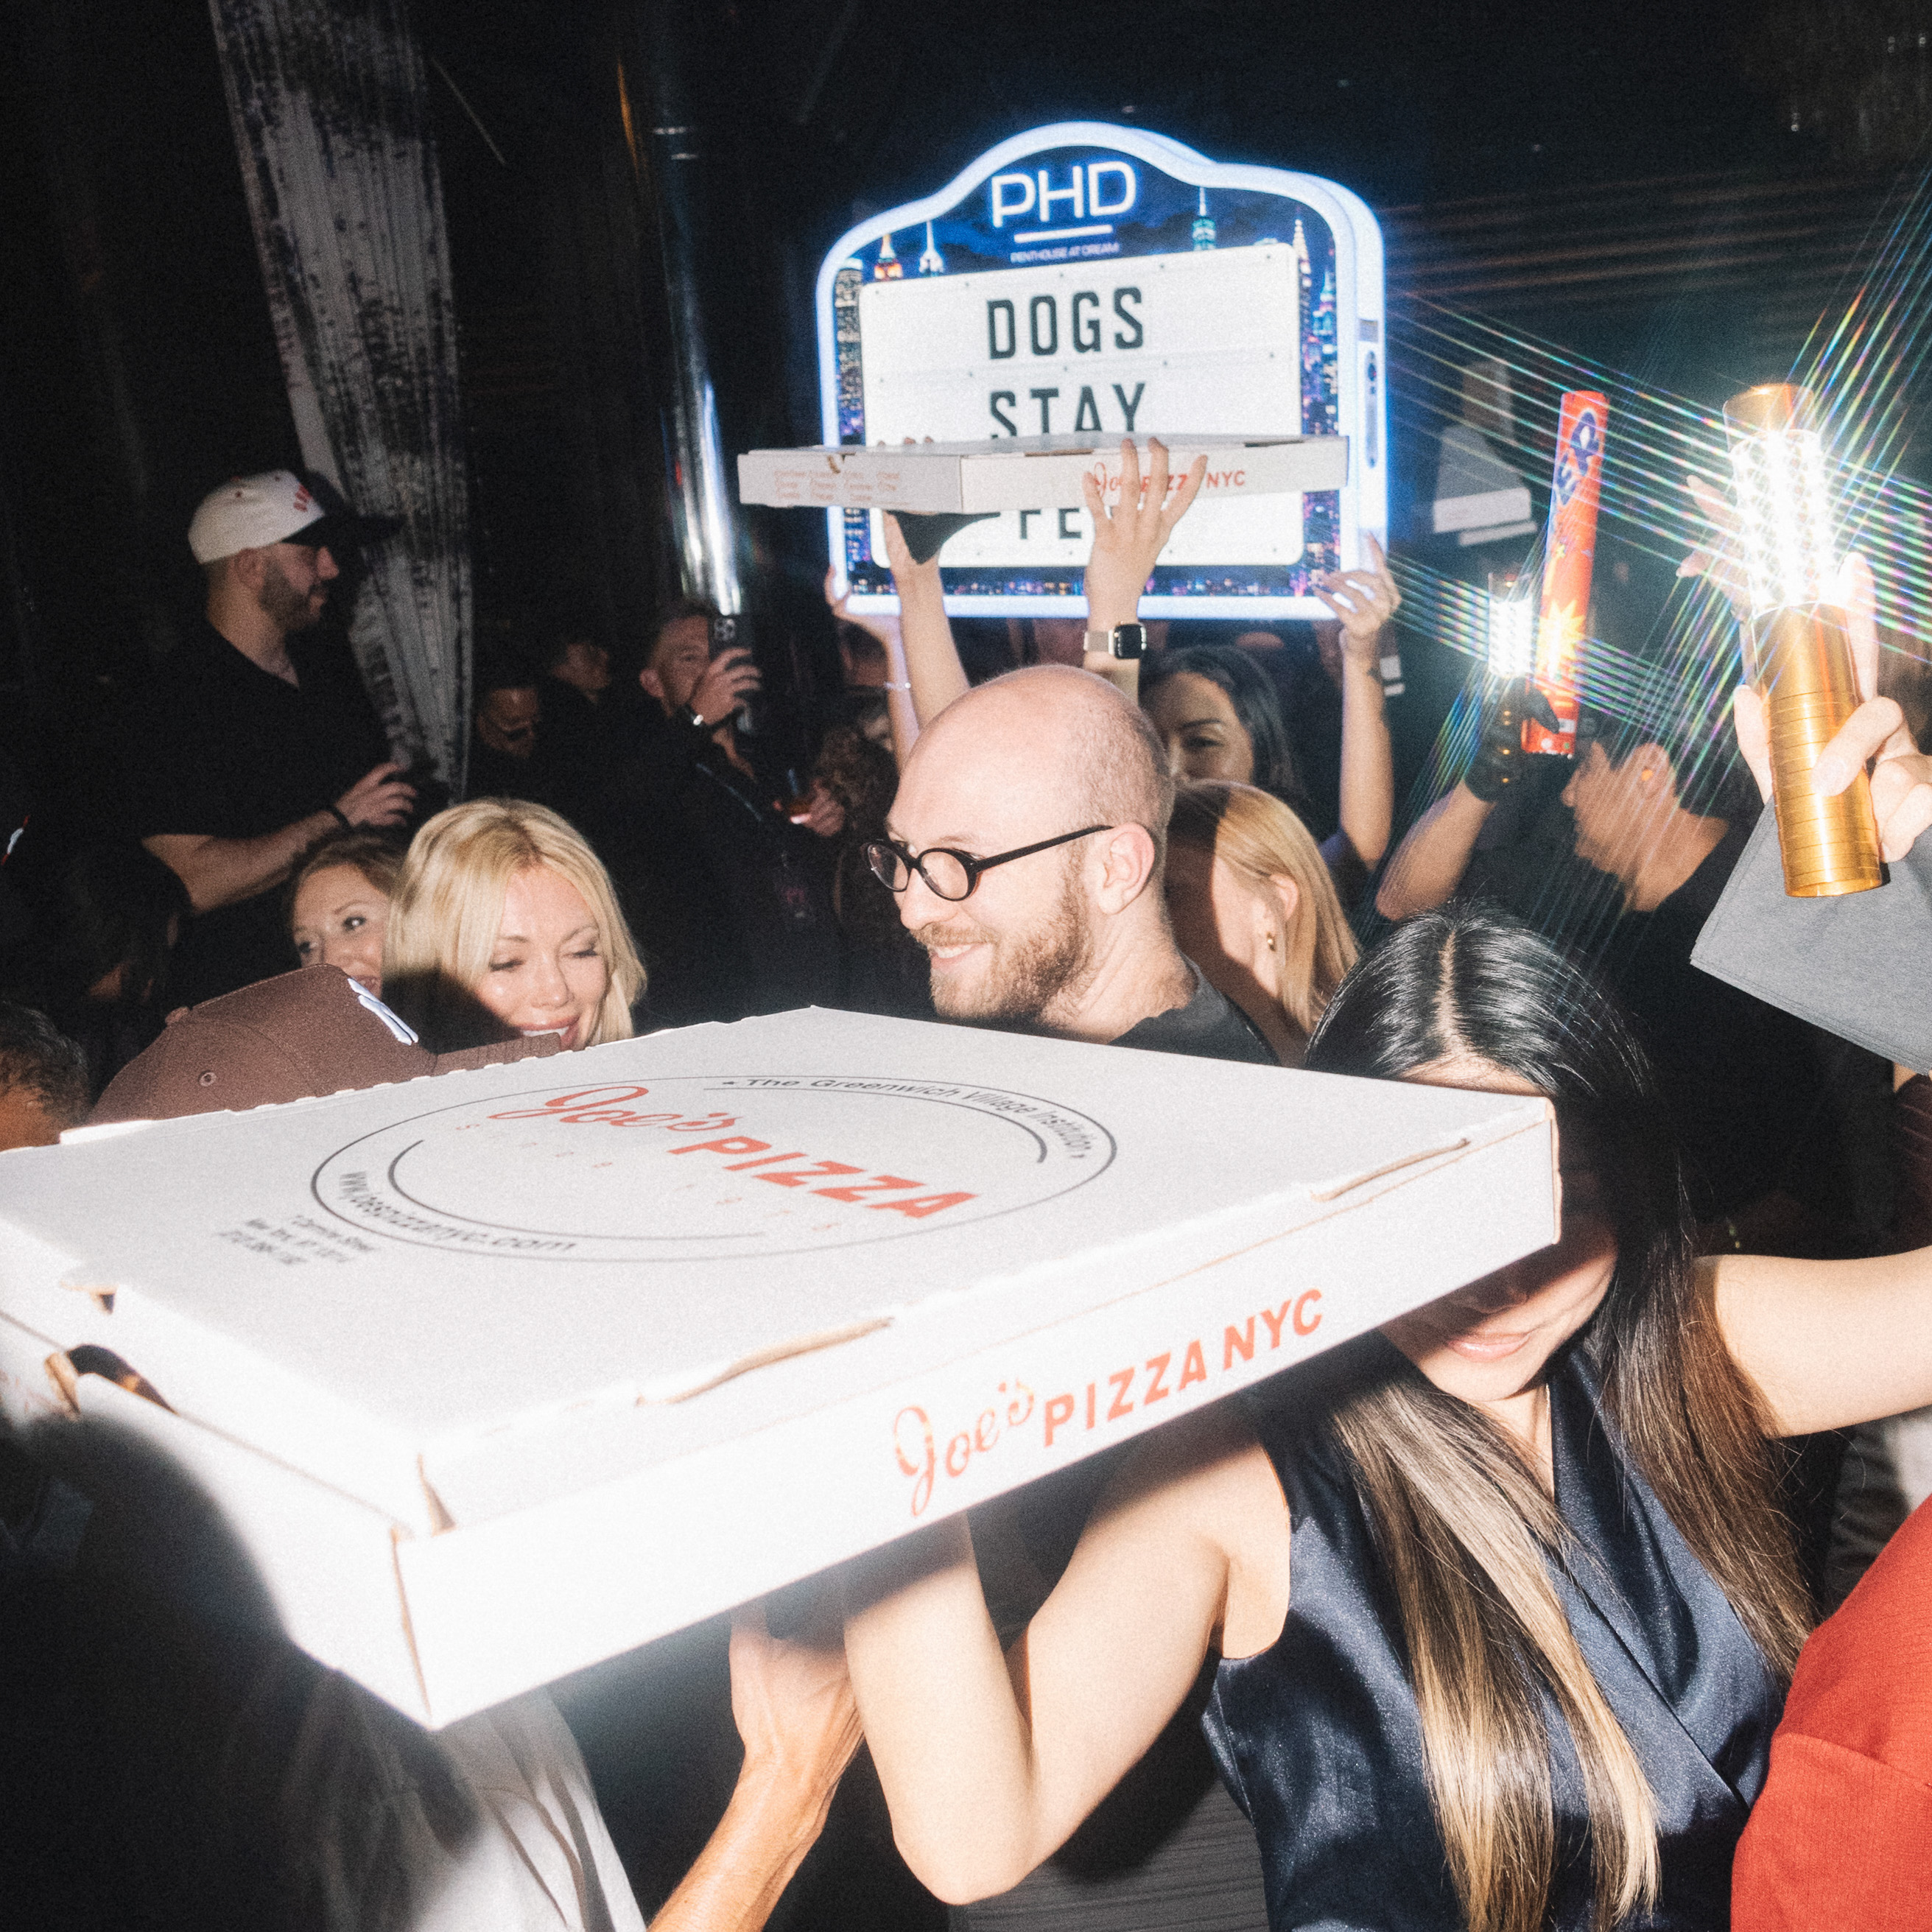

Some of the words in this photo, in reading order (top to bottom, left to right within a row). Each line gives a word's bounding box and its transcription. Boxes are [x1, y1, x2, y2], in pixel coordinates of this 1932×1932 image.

[991, 161, 1137, 228] PHD
[987, 287, 1143, 359] DOGS
[990, 382, 1145, 440] STAY
[1206, 470, 1246, 489] NYC
[746, 1078, 801, 1087] The
[810, 1078, 960, 1097] Greenwich
[962, 1091, 1039, 1114] Village
[486, 1086, 744, 1132] Joe's
[666, 1136, 980, 1219] PIZZA
[893, 1379, 1036, 1517] Joe's
[1044, 1338, 1209, 1448] PIZZA
[1222, 1288, 1324, 1371] NYC
